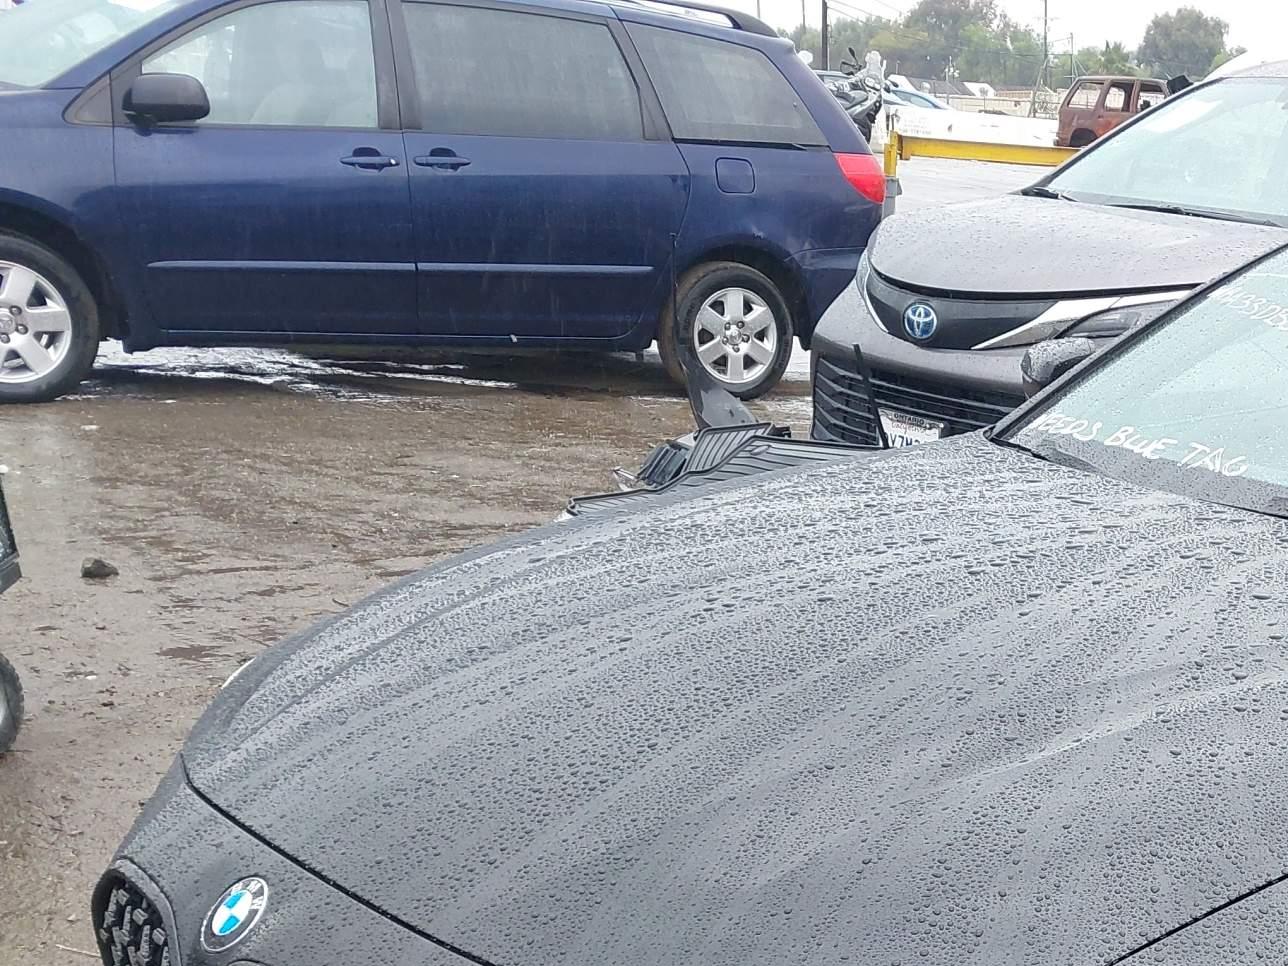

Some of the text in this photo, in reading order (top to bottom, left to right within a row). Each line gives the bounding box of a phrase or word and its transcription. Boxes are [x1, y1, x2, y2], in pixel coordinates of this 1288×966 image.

[894, 413, 925, 426] ONTARIO
[1030, 412, 1250, 477] NEEDS BLUE TAG
